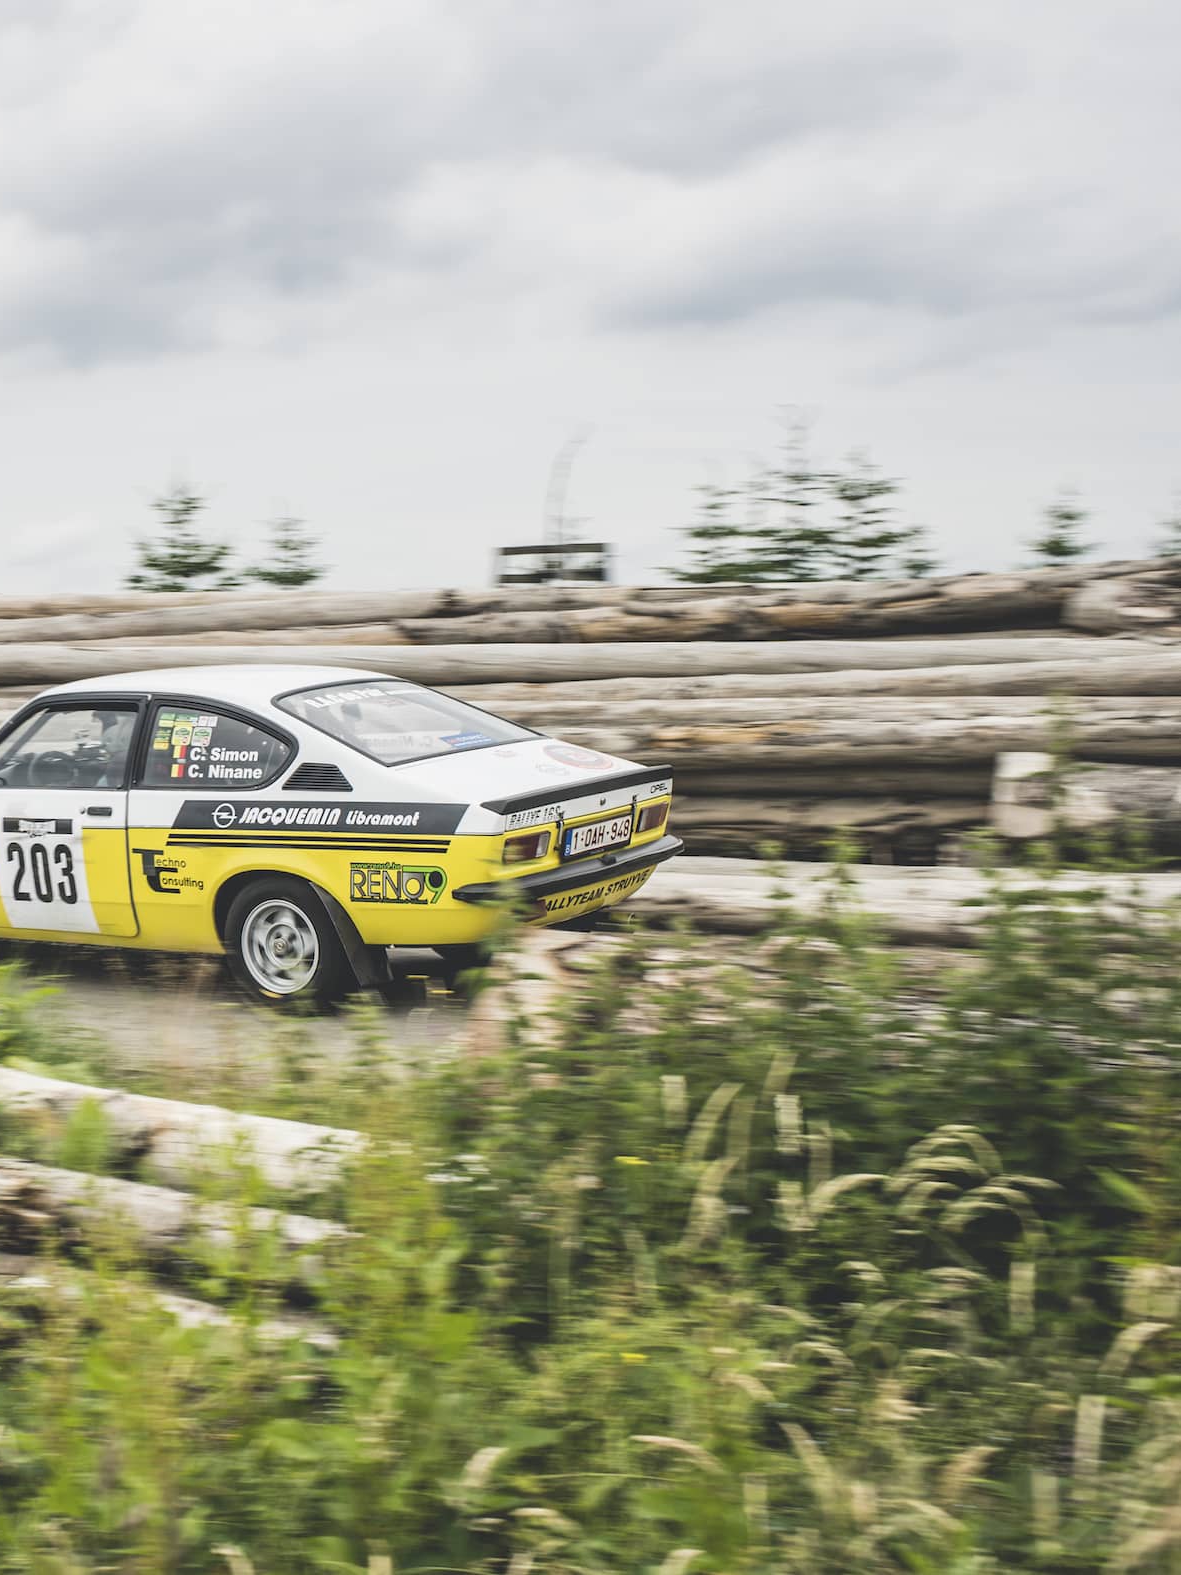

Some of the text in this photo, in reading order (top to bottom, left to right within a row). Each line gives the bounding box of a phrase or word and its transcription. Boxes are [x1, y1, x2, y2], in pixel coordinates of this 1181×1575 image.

[210, 748, 259, 762] Simon
[187, 764, 263, 779] C. Ninane
[650, 783, 668, 794] OPEL
[239, 807, 419, 826] JACQUEMIN Libramont
[6, 842, 78, 904] 203
[544, 886, 605, 912] ALLYTEAM
